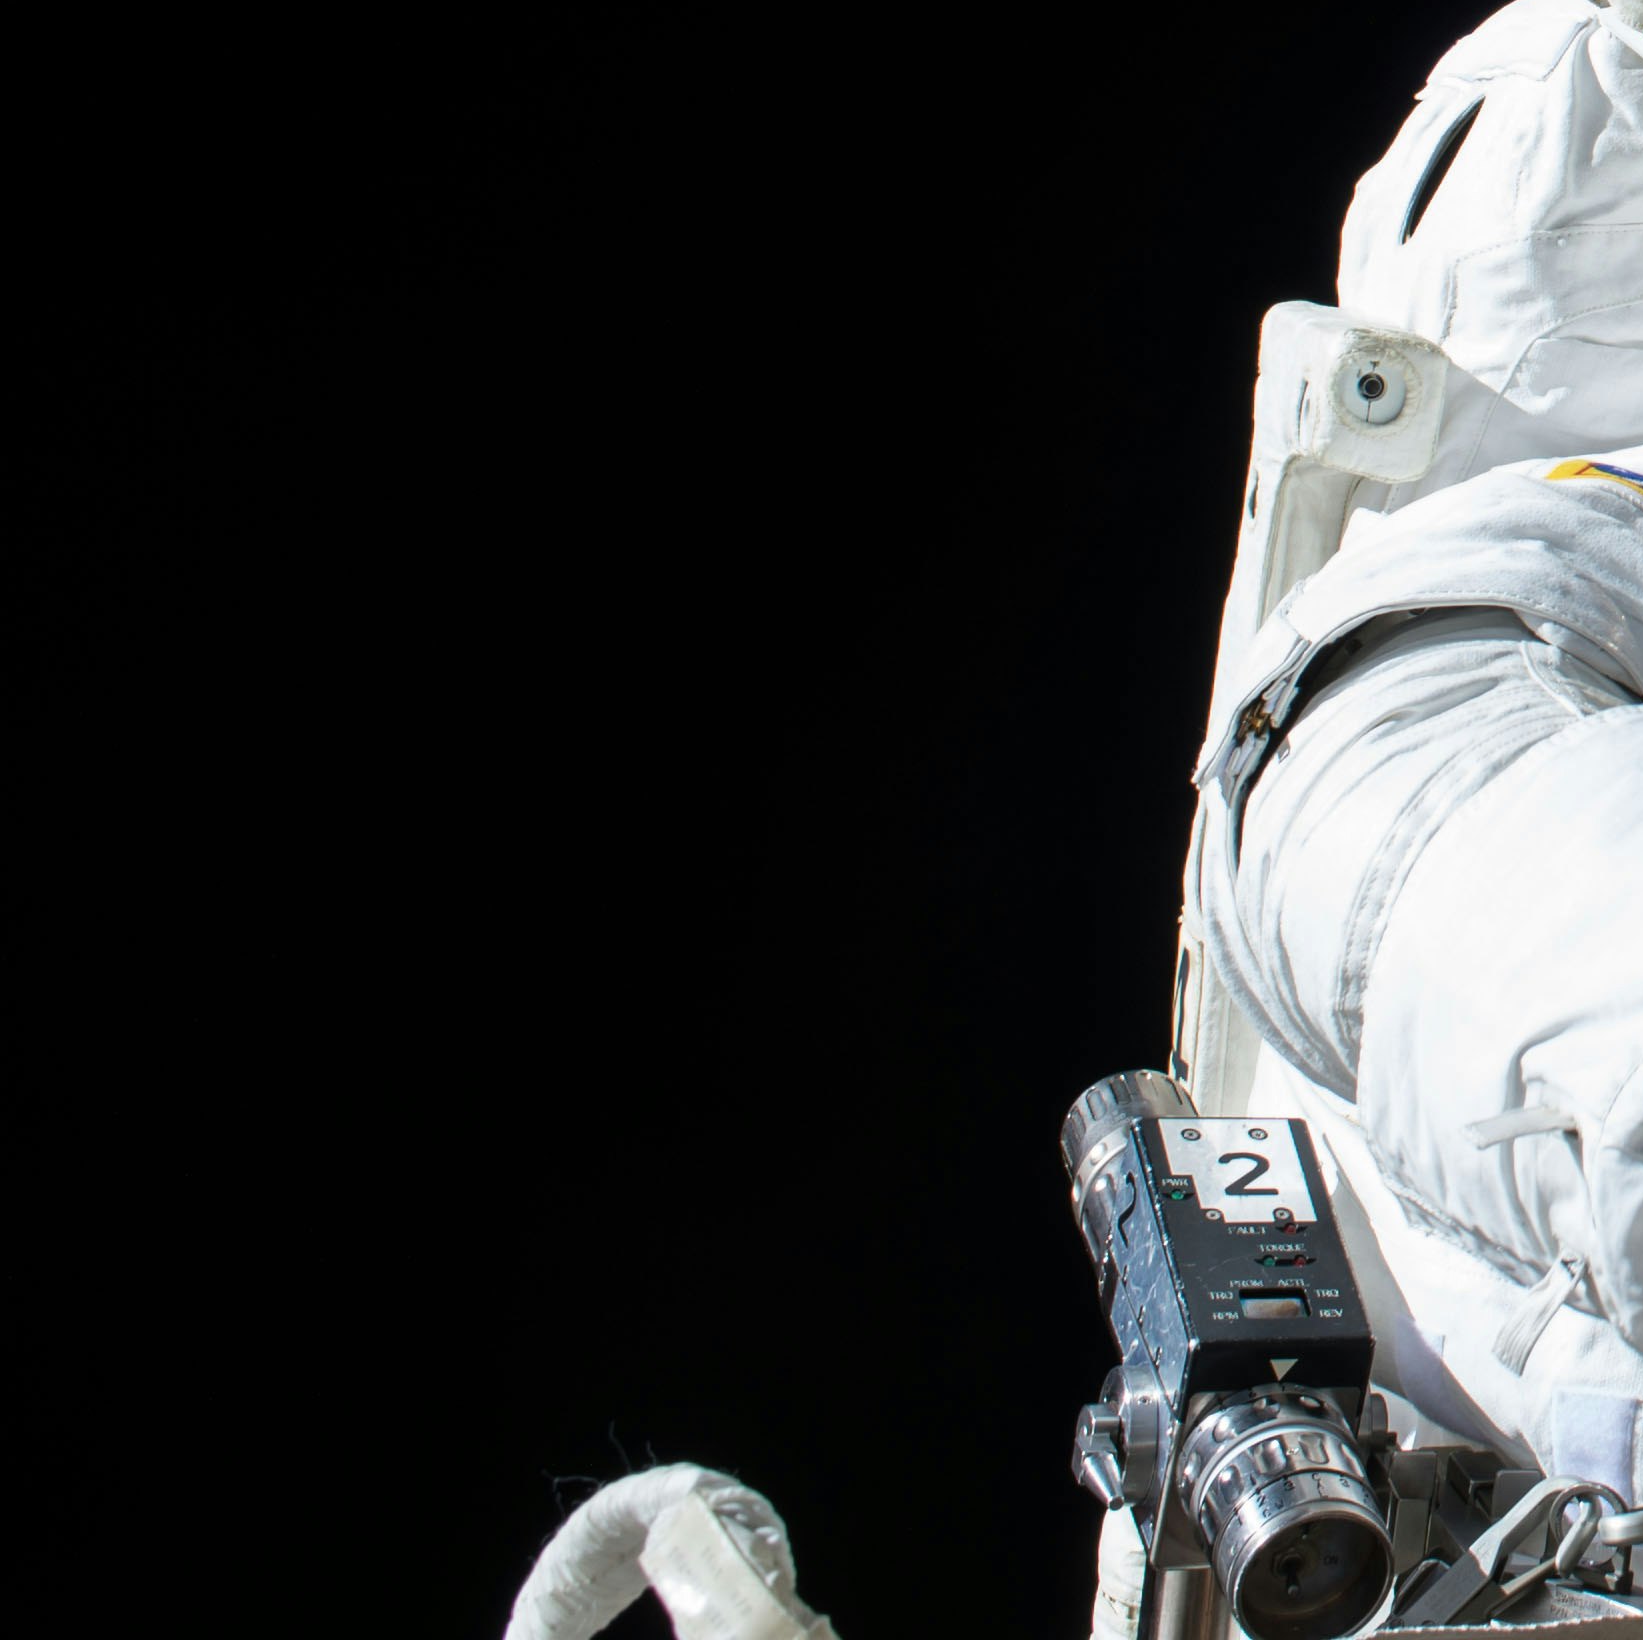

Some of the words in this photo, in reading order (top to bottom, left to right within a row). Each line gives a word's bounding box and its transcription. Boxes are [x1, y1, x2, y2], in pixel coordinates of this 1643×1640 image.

[1218, 1152, 1280, 1196] 2
[1161, 1178, 1189, 1187] PWR
[1227, 1225, 1266, 1235] FAULT
[1260, 1242, 1307, 1252] TORQUE
